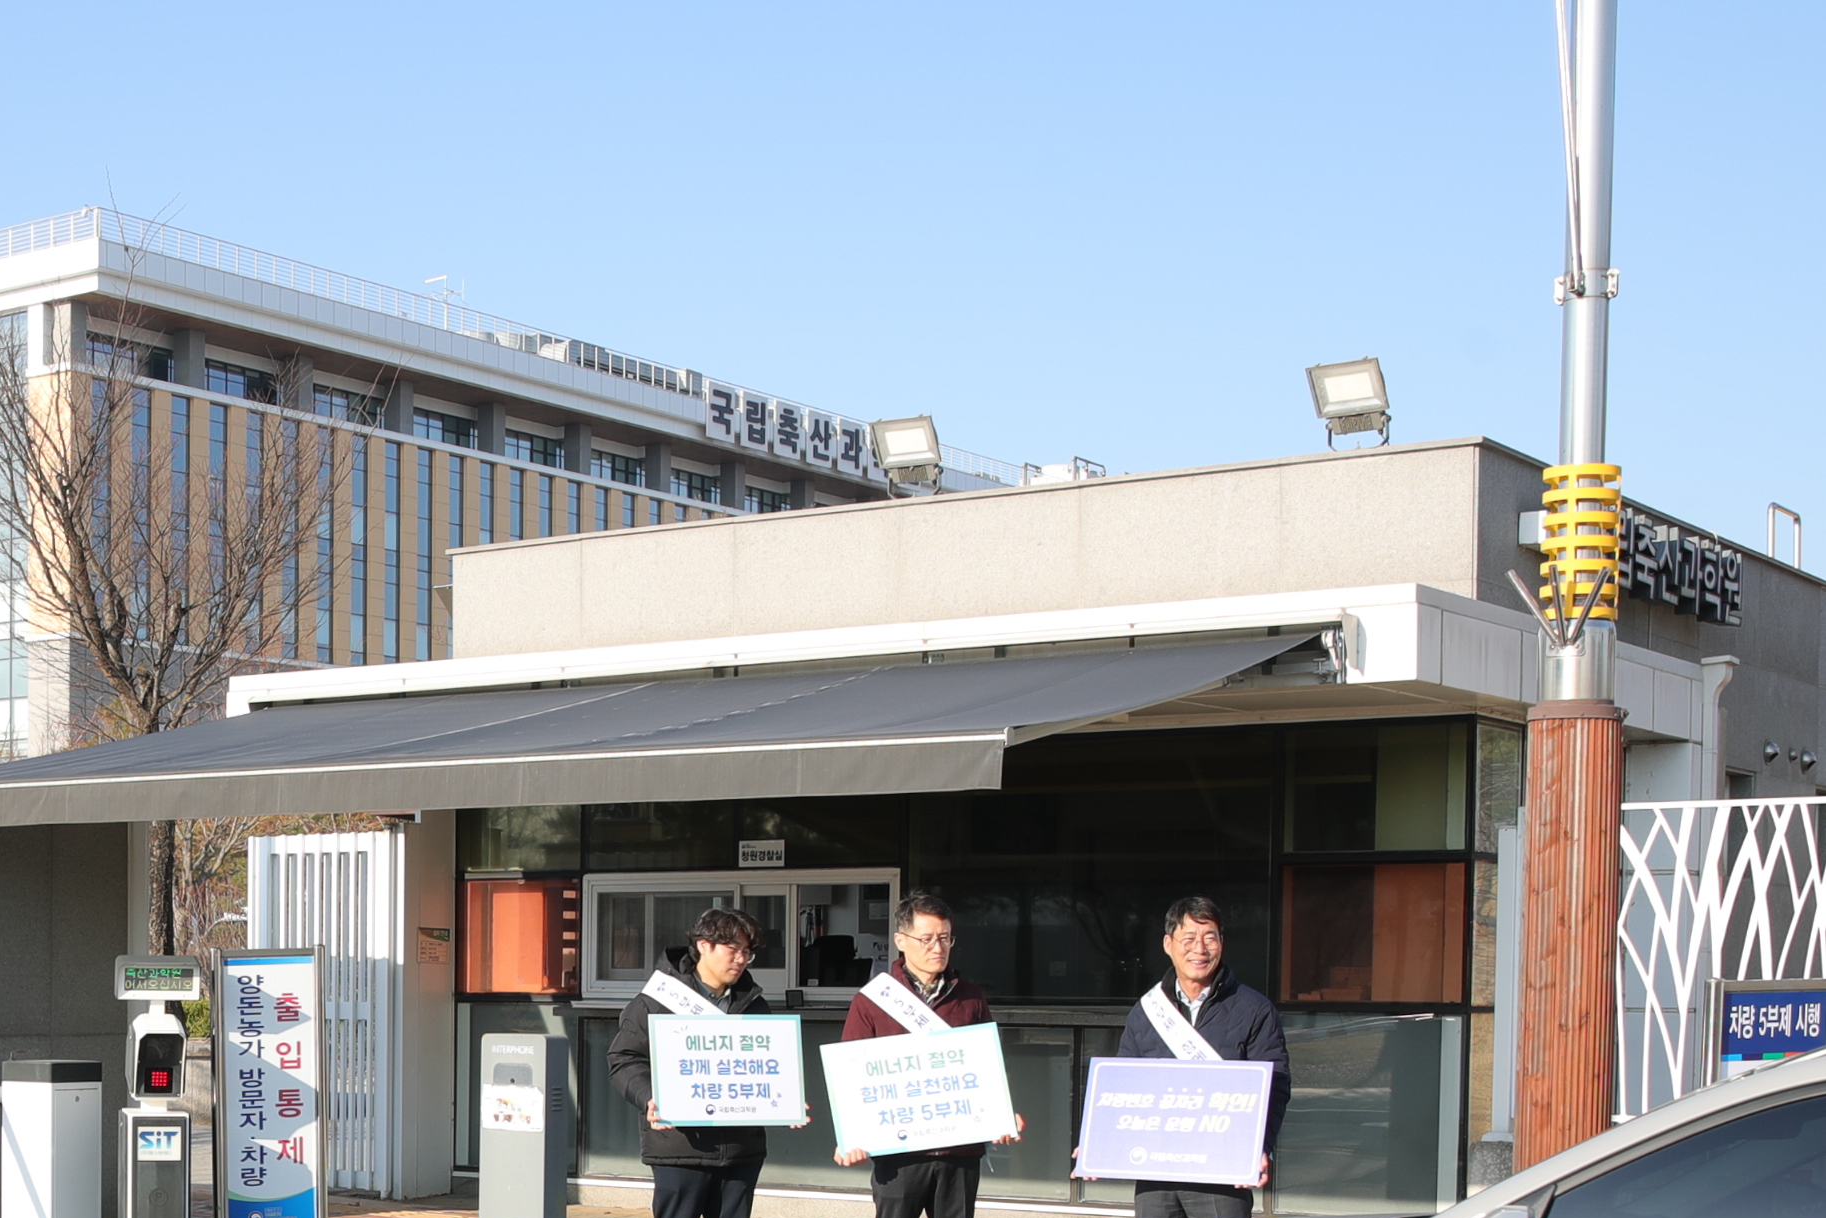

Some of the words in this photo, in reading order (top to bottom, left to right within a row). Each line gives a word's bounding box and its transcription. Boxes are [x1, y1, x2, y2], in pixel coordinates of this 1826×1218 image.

[710, 389, 888, 477] 국립축산과
[1618, 507, 1742, 627] 립축산과학원
[125, 979, 193, 990] 어서오십시오
[237, 974, 265, 1059] 양돈농가
[1729, 1004, 1756, 1039] 차량
[1759, 1003, 1793, 1037] 5부제
[1795, 1002, 1821, 1037] 시행
[685, 1035, 733, 1051] 에너지
[739, 1035, 771, 1051] 절약
[678, 1058, 711, 1075] 함께
[716, 1058, 780, 1075] 실천해요
[865, 1055, 922, 1076] 에너지
[928, 1049, 965, 1069] 절약
[273, 993, 304, 1165] 출입통제
[691, 1083, 722, 1099] 차량
[727, 1083, 771, 1099] 5부제
[860, 1083, 898, 1103] 함께
[904, 1072, 979, 1098] 실천해요
[878, 1106, 914, 1127] 차량
[921, 1099, 972, 1121] 5부제
[1115, 1114, 1161, 1132] 오늘은
[1198, 1114, 1231, 1133] NO
